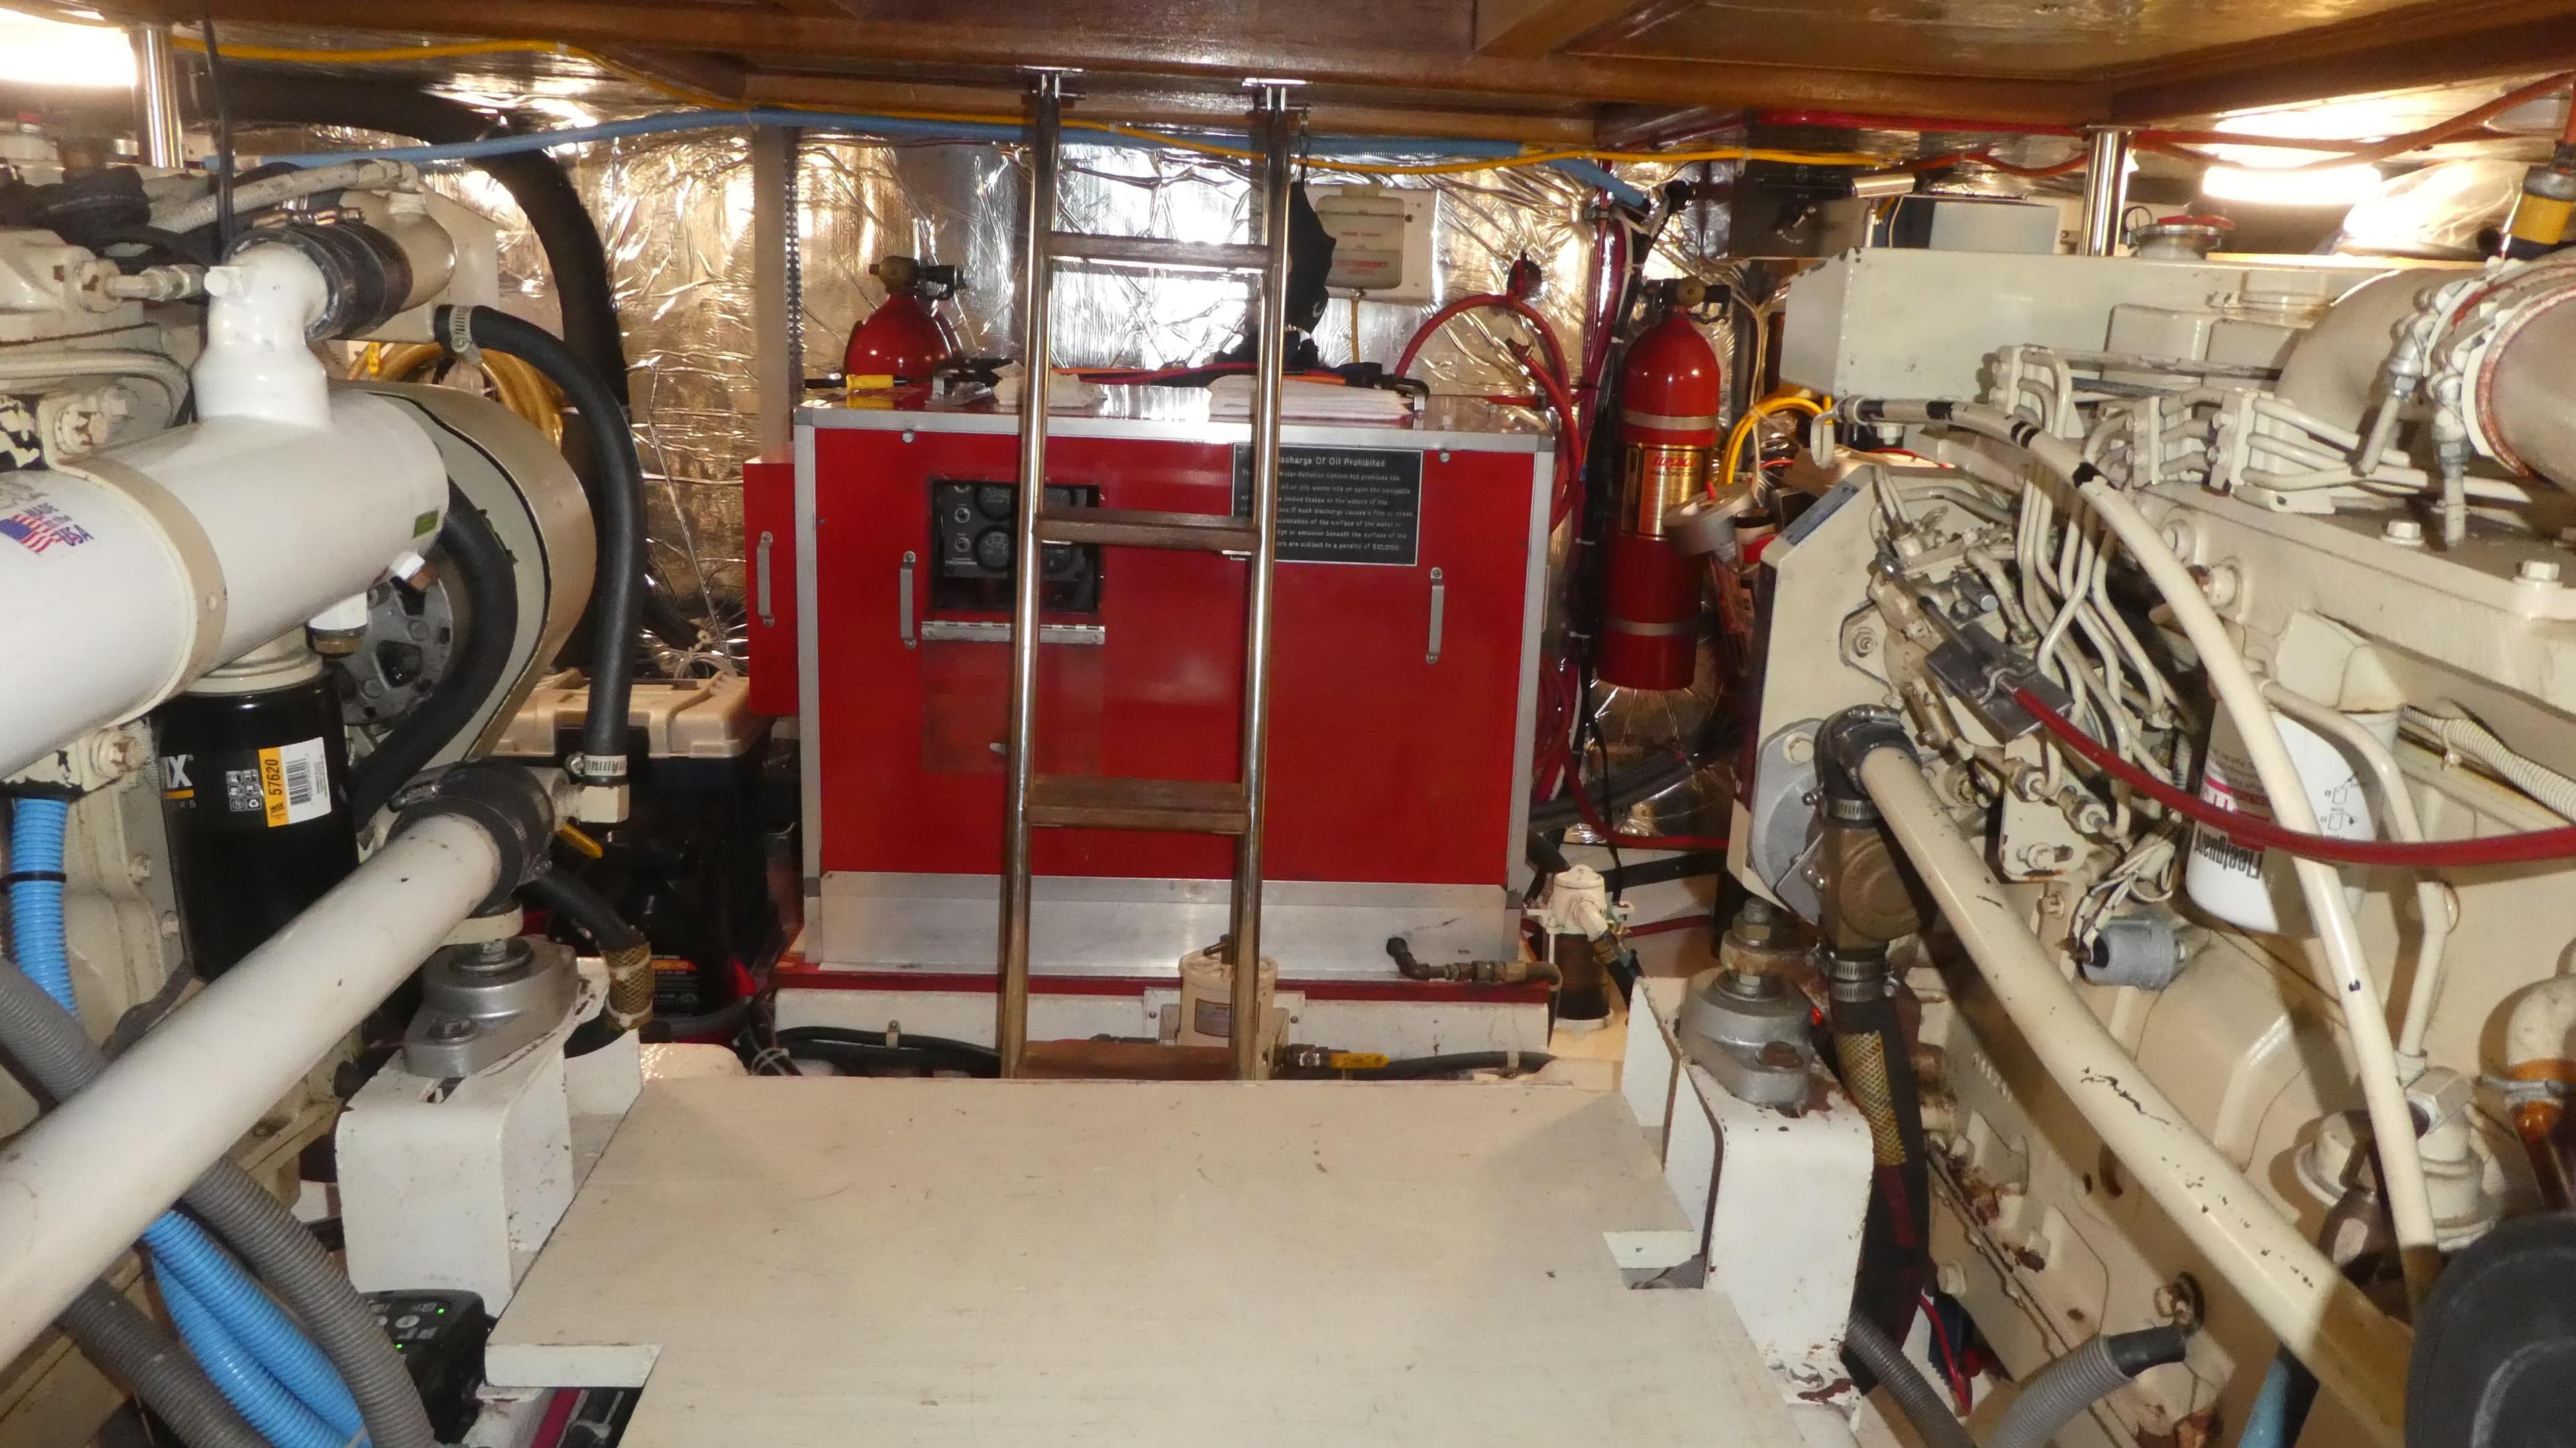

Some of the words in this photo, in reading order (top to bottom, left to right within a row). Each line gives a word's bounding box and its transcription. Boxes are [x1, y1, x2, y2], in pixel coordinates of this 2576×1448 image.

[1315, 456, 1326, 465] Of
[1328, 456, 1341, 466] Oil
[1344, 457, 1385, 468] Prohibited
[1283, 495, 1303, 503] United
[1314, 507, 1343, 516] discharge
[54, 523, 95, 547] USA
[1300, 540, 1324, 548] subject
[1338, 541, 1361, 550] penalty
[264, 758, 283, 796] 57620
